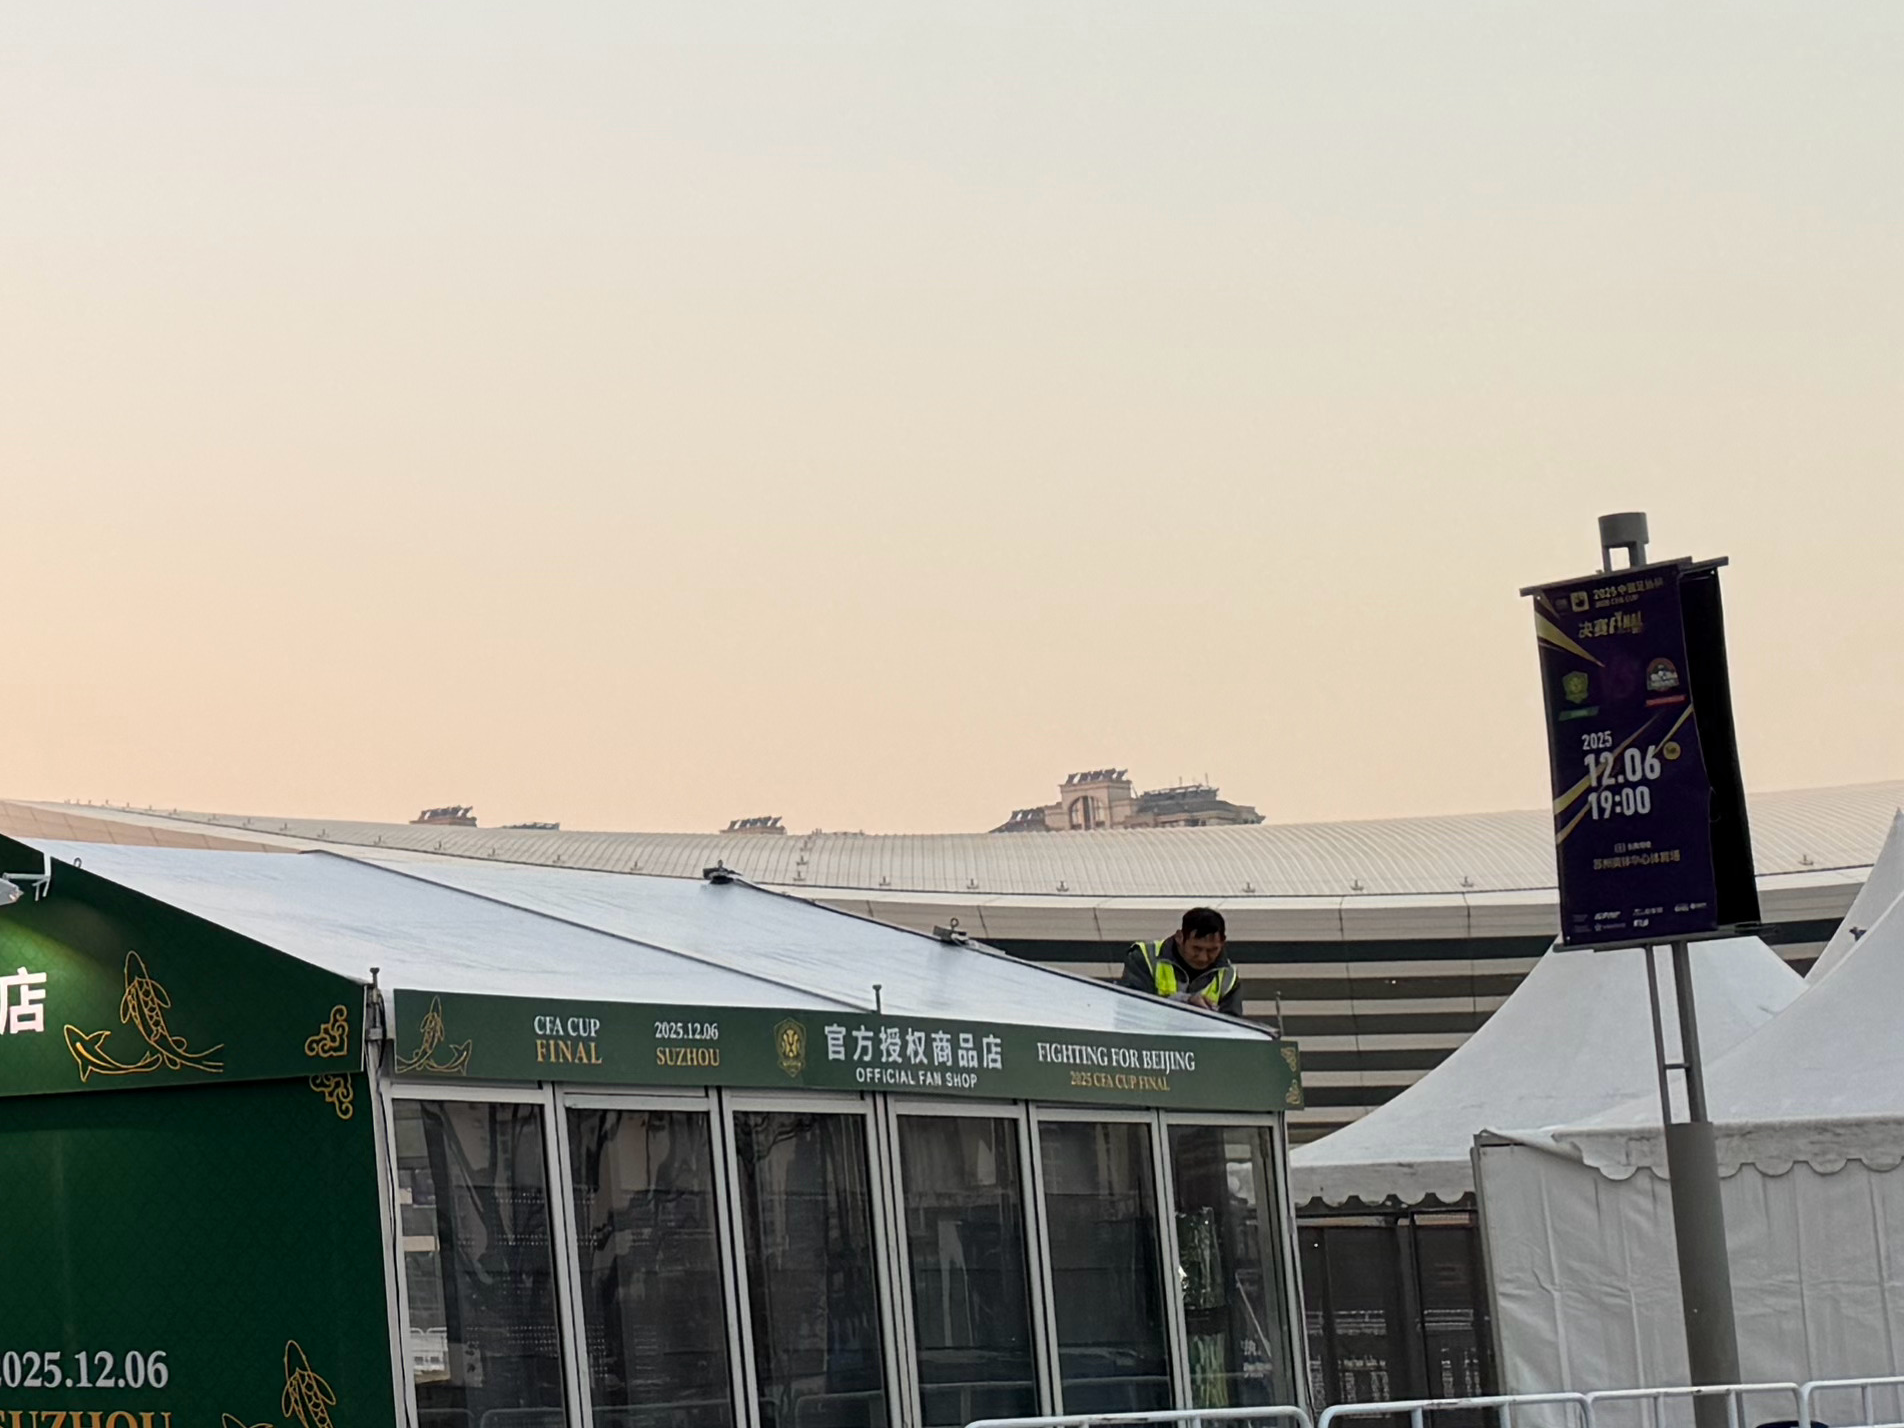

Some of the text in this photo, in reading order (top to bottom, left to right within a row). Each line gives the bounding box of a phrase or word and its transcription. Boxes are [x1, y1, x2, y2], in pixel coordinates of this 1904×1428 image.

[1581, 730, 1612, 750] 2025
[1584, 745, 1661, 787] 12.06
[1587, 785, 1651, 820] 19:00
[534, 1016, 600, 1037] CFA CUP
[654, 1021, 719, 1040] 2025.12.06
[536, 1039, 603, 1064] FINAL
[656, 1047, 720, 1066] SUZHOU
[824, 1023, 1002, 1069] 官方授权商品店
[1037, 1043, 1196, 1074] FIGHTING FOR BEIJING
[856, 1067, 978, 1088] OFFICIAL FAN SHOP
[1070, 1071, 1171, 1091] 2025 CFA CUP FINAL
